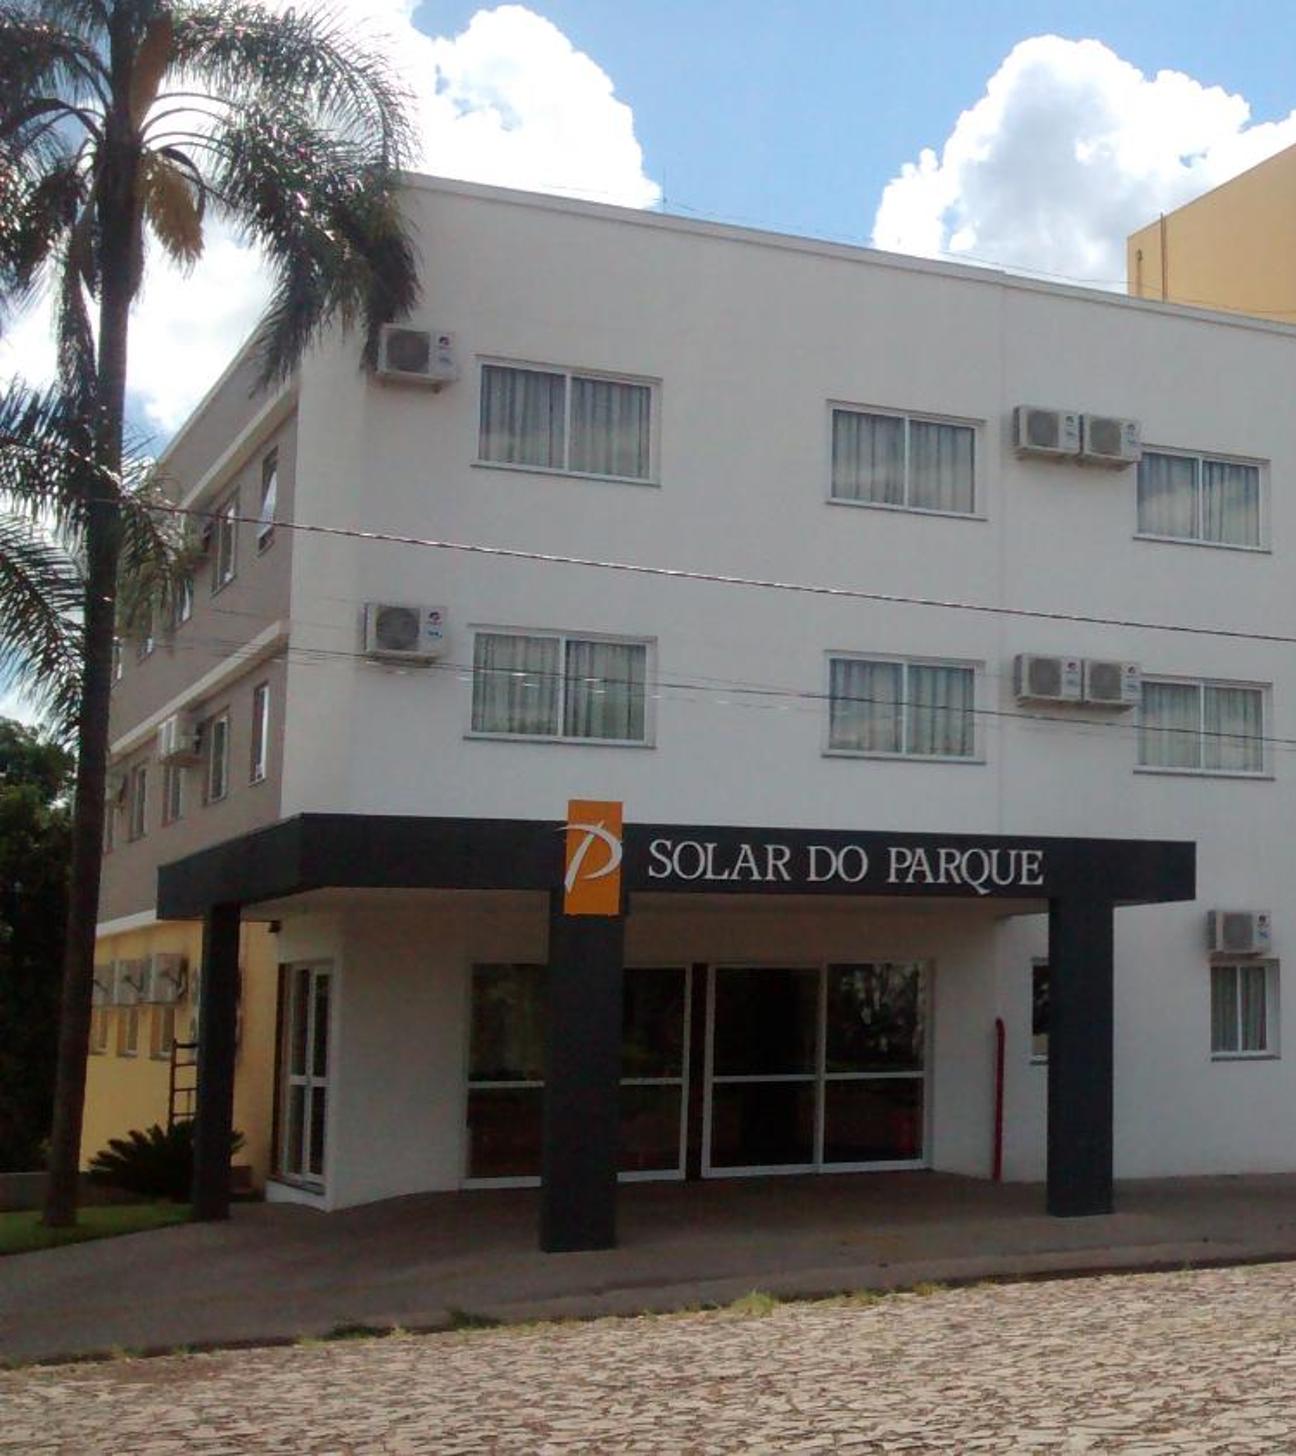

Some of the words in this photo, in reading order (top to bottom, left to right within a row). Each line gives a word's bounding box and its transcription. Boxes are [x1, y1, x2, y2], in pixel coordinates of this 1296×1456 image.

[648, 838, 792, 881] SOLAR
[806, 845, 868, 882] DO
[887, 847, 1044, 895] PARQUE
